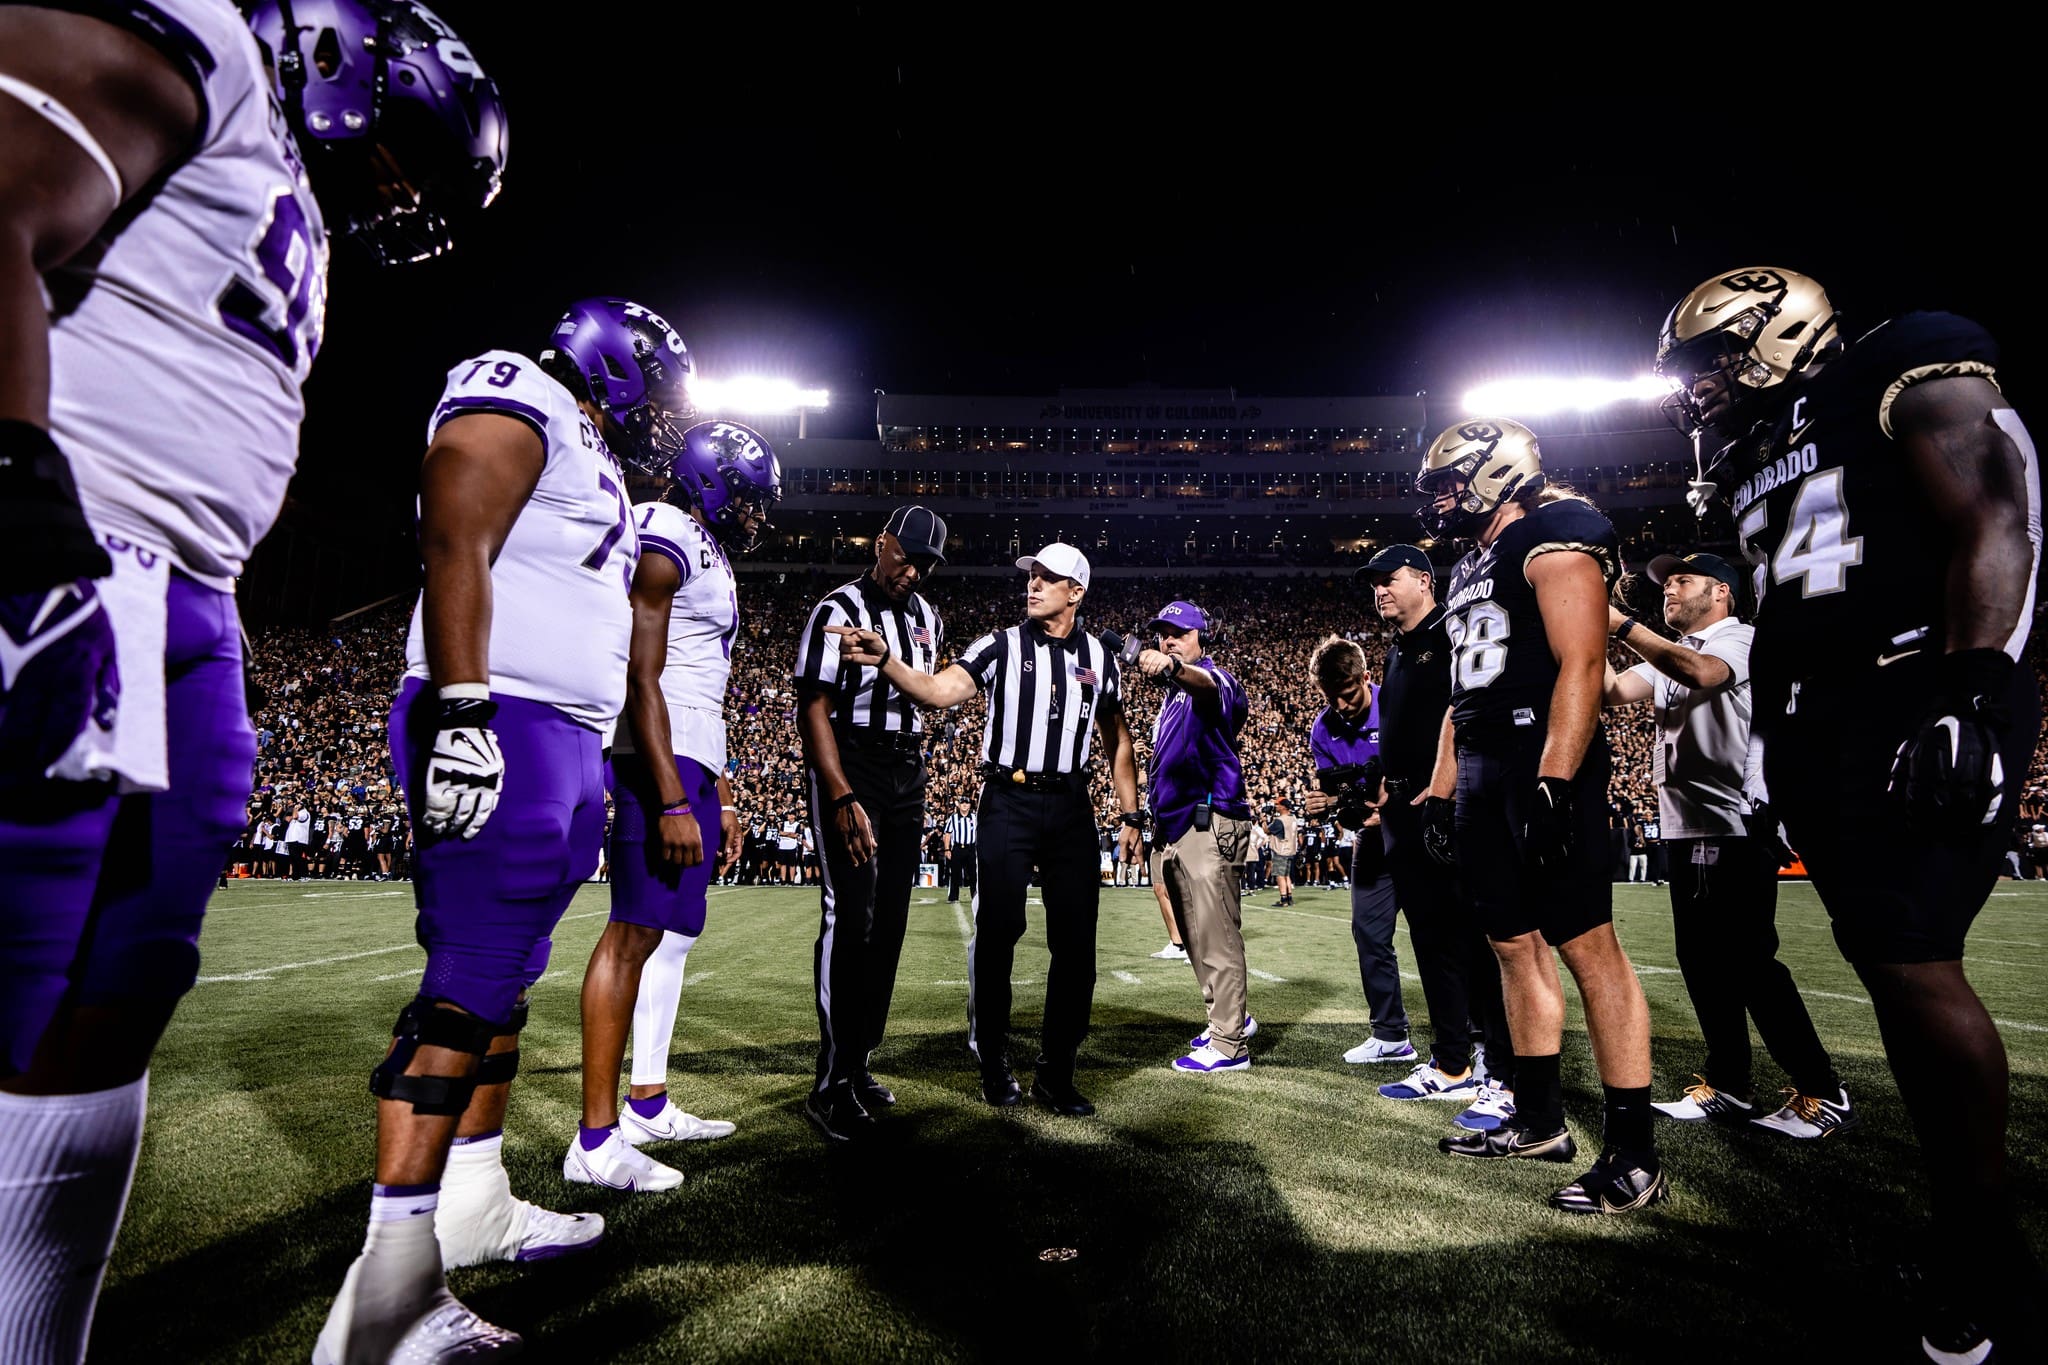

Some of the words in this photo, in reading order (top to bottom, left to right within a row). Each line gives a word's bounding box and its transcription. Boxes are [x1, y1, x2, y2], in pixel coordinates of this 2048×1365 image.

[624, 301, 687, 354] TCU
[461, 360, 521, 388] 79
[1064, 405, 1142, 420] UNIVERSITY
[1146, 405, 1160, 420] OF
[1165, 405, 1237, 420] COLORADO
[1793, 396, 1807, 430] C
[709, 423, 764, 461] TCU
[640, 507, 655, 529] 1
[1738, 466, 1864, 620] 54
[700, 548, 711, 569] C
[1023, 660, 1033, 672] S
[1080, 702, 1090, 719] R
